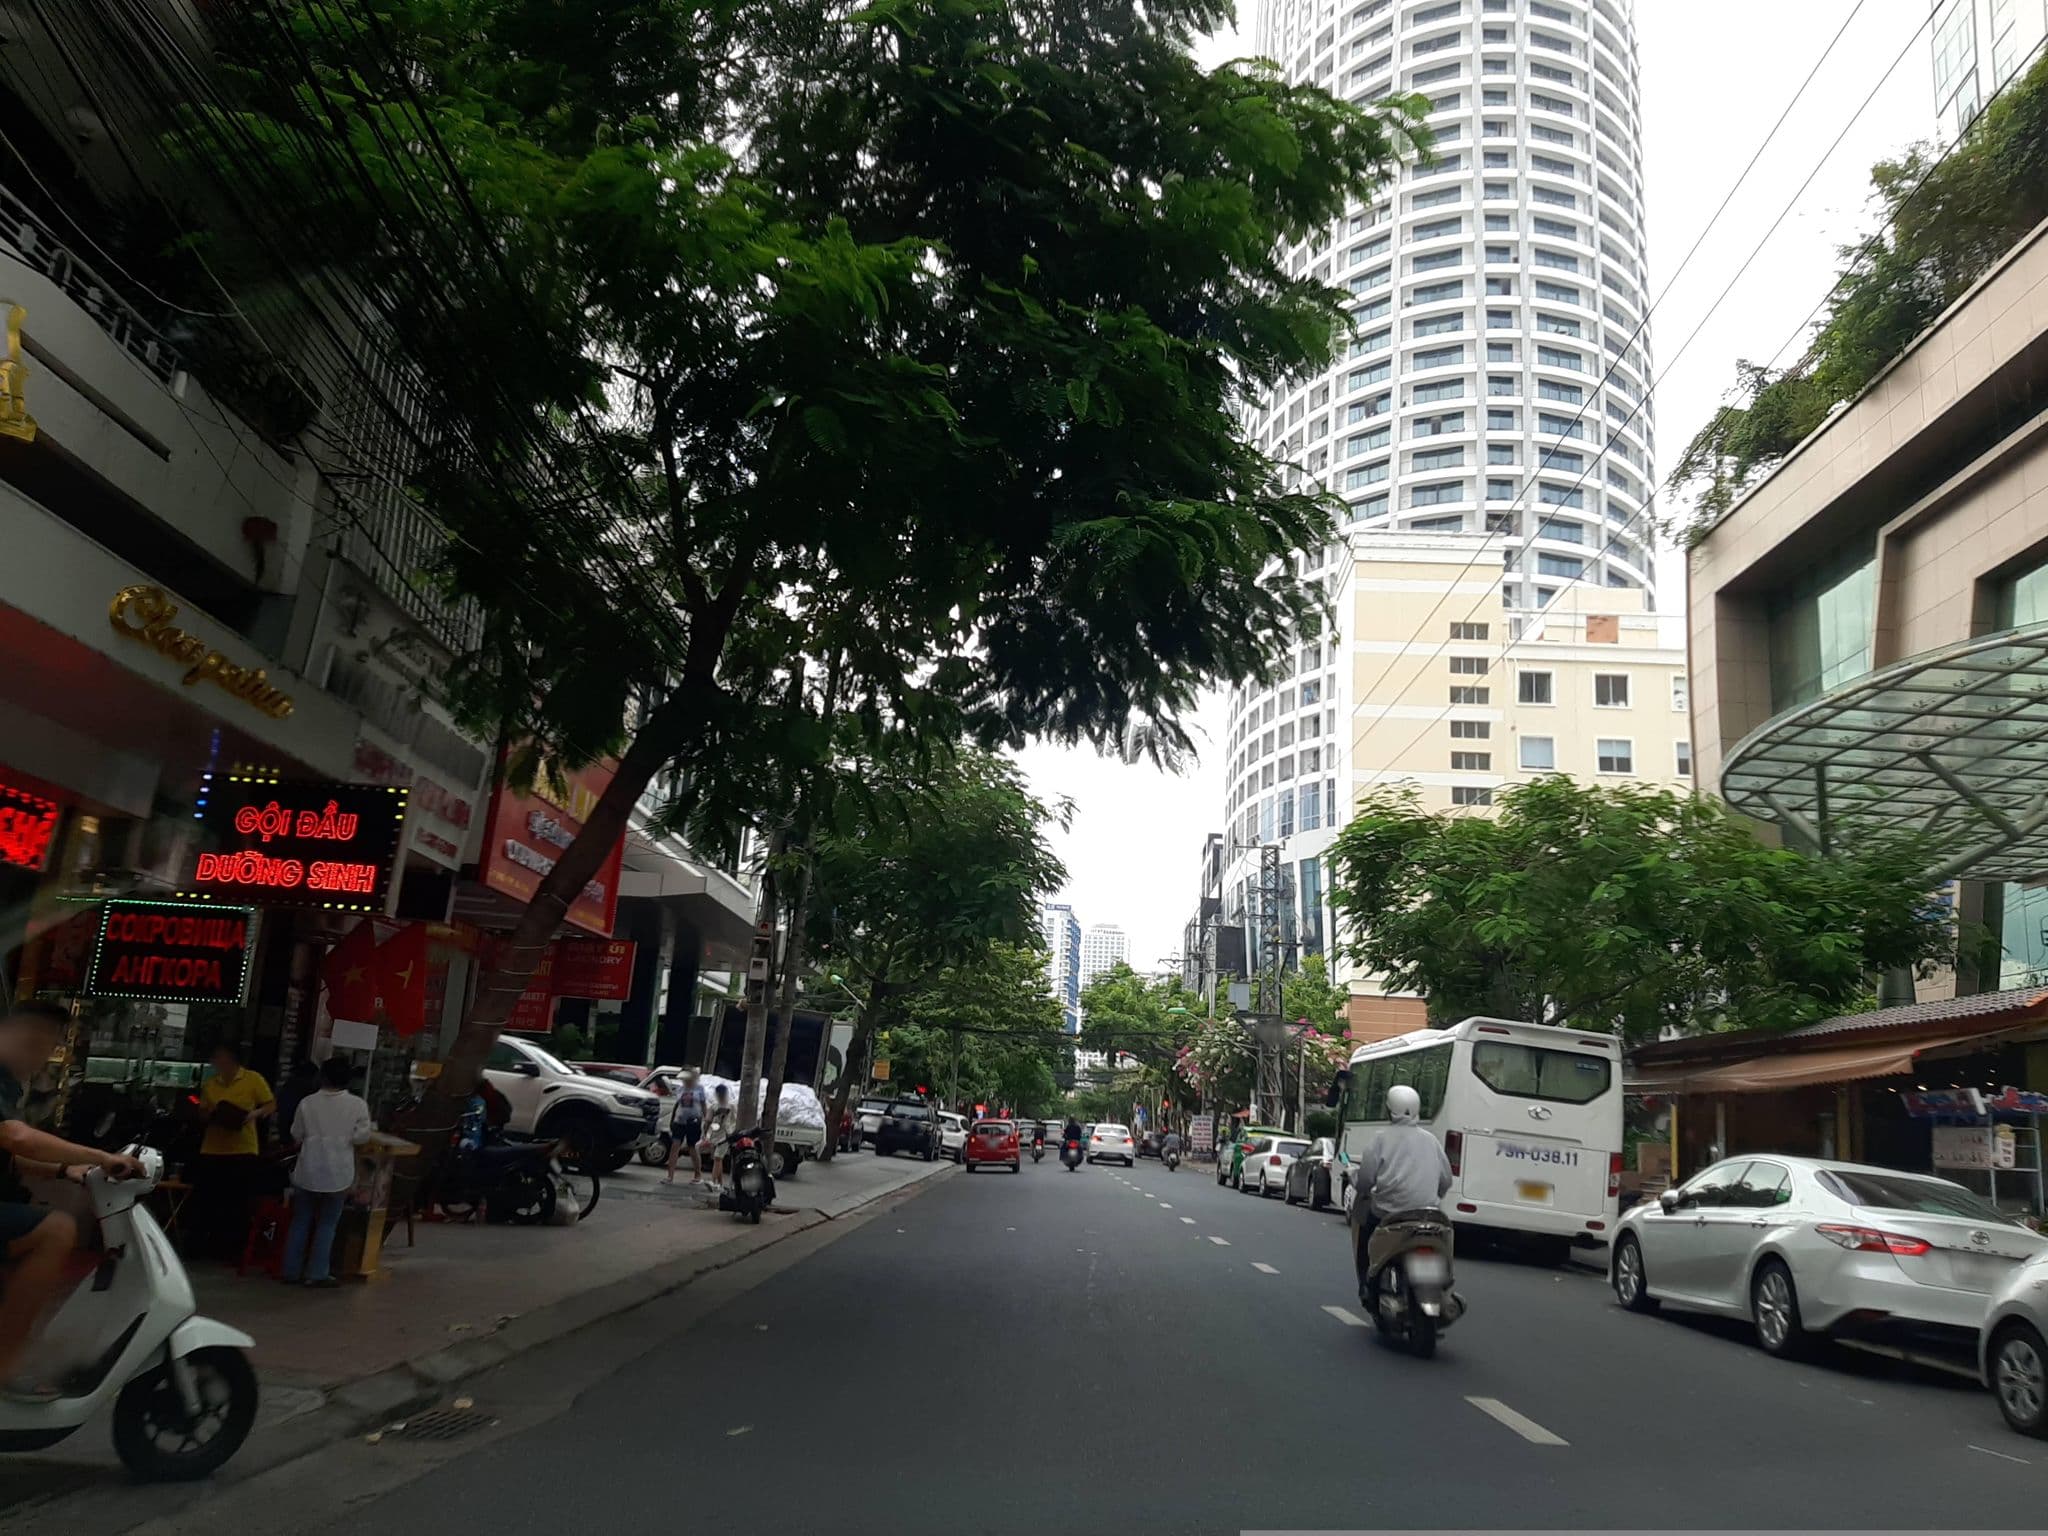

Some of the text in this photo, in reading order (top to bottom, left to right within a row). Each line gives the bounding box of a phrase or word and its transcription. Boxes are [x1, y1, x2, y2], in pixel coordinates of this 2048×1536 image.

[234, 799, 360, 842] GỘI ĐẦU
[195, 851, 377, 893] DƯỠNG SINH
[106, 912, 247, 952] СОКРОВИЩА
[111, 954, 223, 991] АНГКОРА
